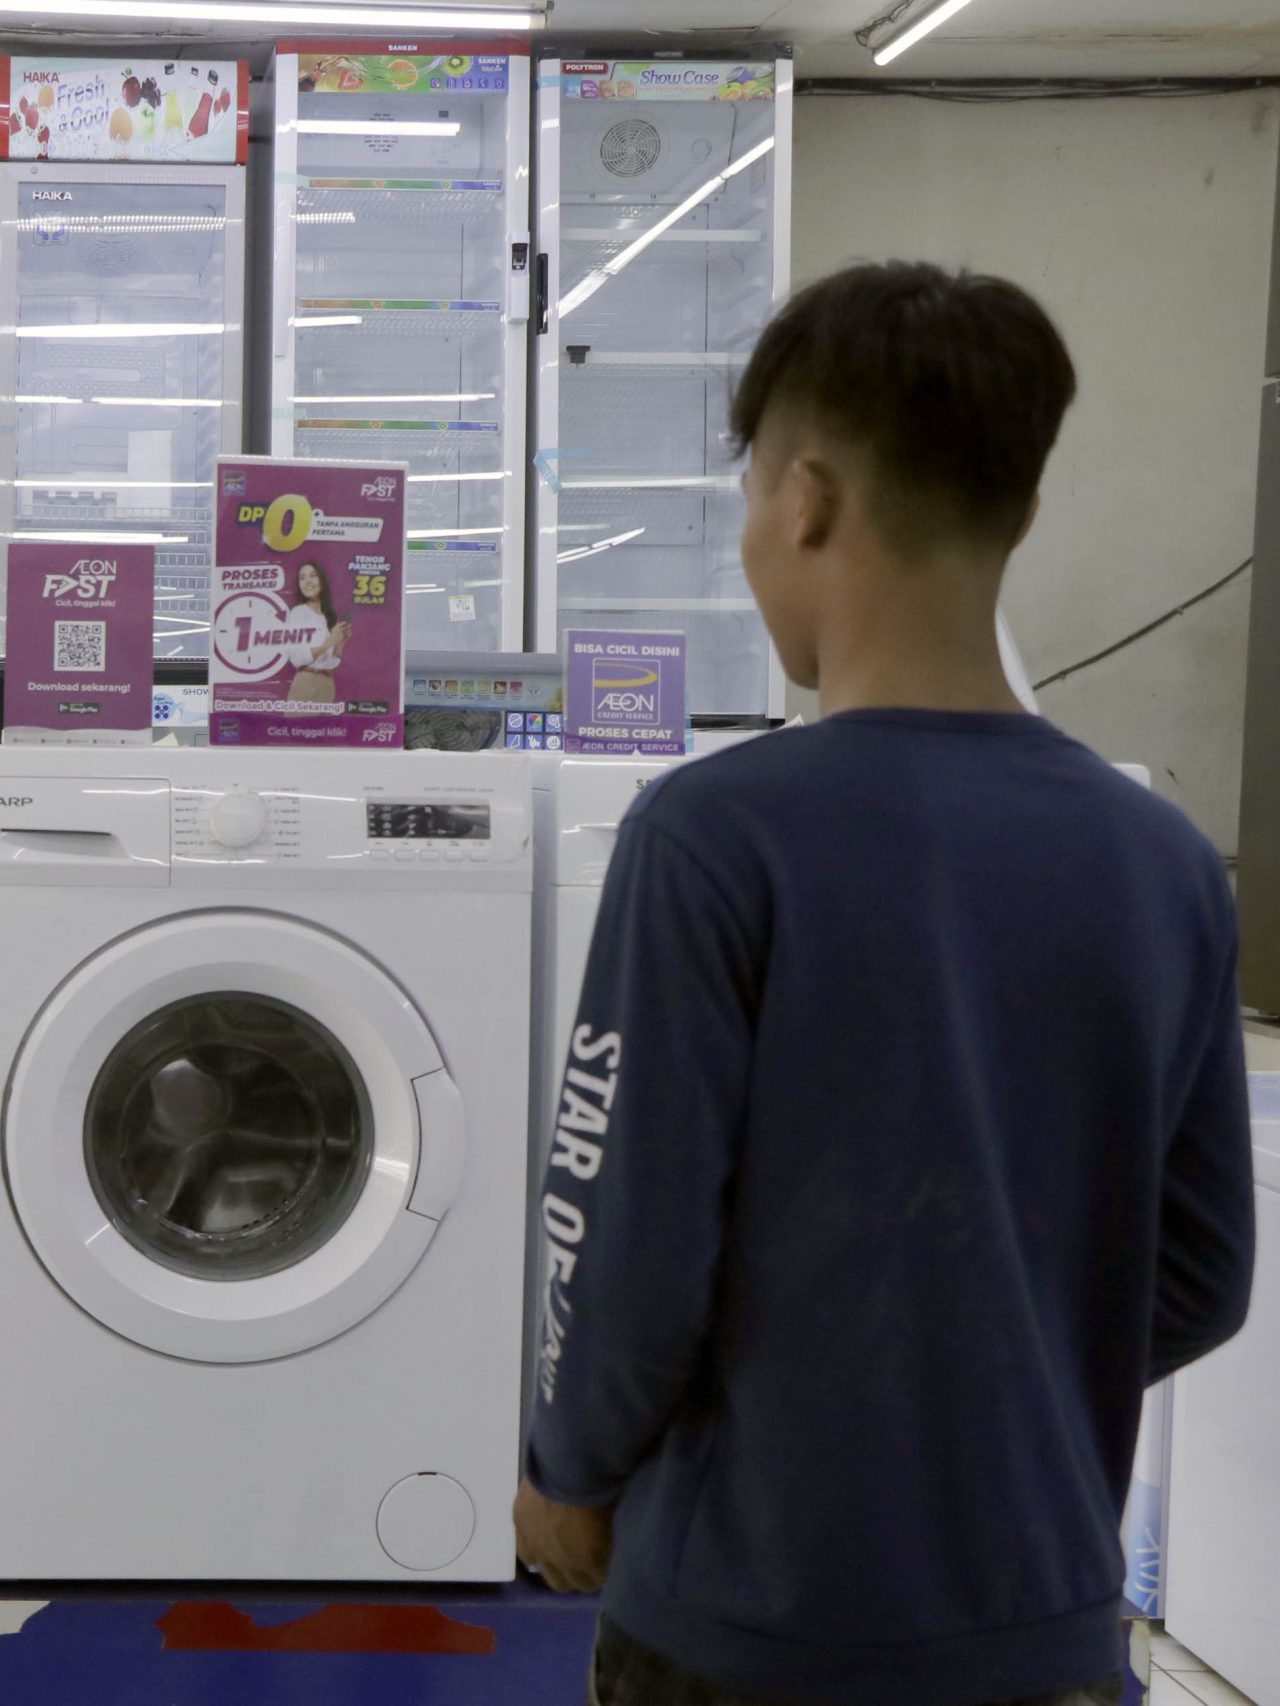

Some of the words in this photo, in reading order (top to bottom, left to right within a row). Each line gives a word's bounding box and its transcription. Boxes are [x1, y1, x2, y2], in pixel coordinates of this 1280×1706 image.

[23, 71, 60, 83] HAIKA
[32, 191, 72, 200] HAIKA
[238, 506, 265, 523] DP
[355, 555, 386, 564] TENOR
[221, 568, 278, 582] PROSES
[222, 581, 277, 590] TRANSAKSI
[352, 575, 387, 596] 36
[74, 599, 99, 609] tinggal
[235, 616, 253, 652] 1
[253, 627, 317, 647] MENIT
[573, 643, 604, 655] BISA
[607, 644, 639, 656] CICIL
[641, 645, 680, 657] DISINI
[28, 682, 79, 692] Download
[81, 683, 131, 694] sekarang!
[215, 701, 263, 711] Download
[275, 702, 295, 711] Cicil
[297, 702, 344, 713] Sekarang!
[291, 727, 326, 738] tinggal
[327, 728, 347, 737] klik!
[578, 727, 631, 738] PROSES
[634, 728, 673, 740] CEPAT
[607, 743, 639, 752] CREDIT
[641, 743, 679, 752] SERVICE
[550, 1023, 622, 1181] STAR
